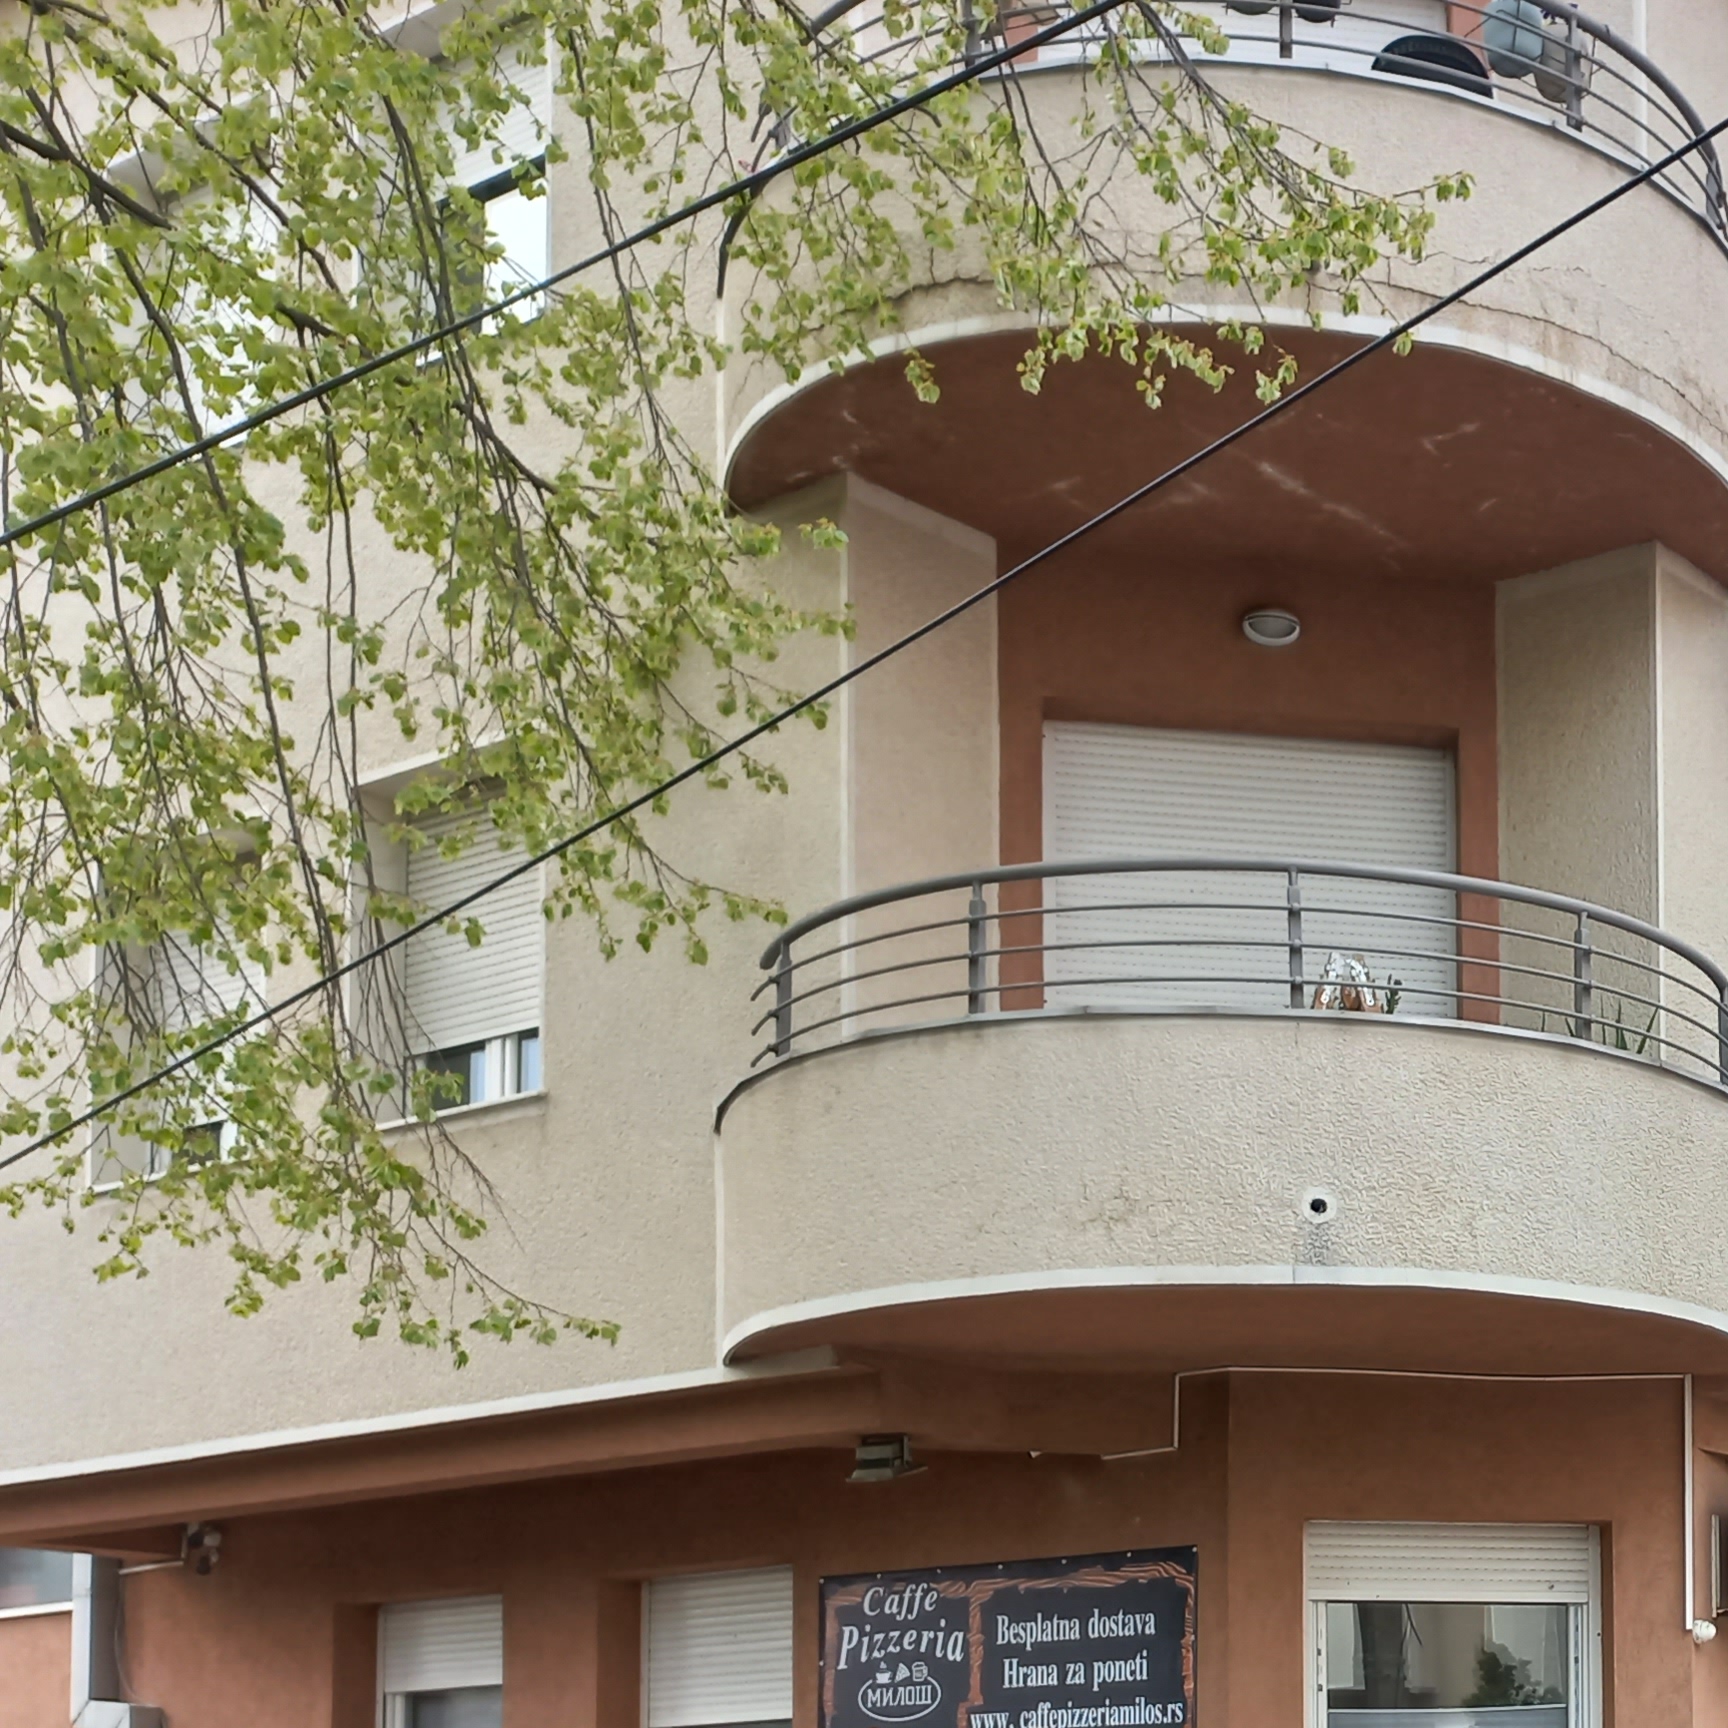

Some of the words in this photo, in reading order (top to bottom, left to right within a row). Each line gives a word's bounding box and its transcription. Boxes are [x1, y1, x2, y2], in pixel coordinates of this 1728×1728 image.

[864, 1583, 938, 1620] Caffe
[837, 1619, 963, 1669] Pizzeria
[997, 1613, 1080, 1651] Besplatna
[1088, 1609, 1155, 1638] dostava
[1003, 1659, 1057, 1688] Hrana
[1066, 1663, 1085, 1684] za
[1093, 1650, 1147, 1691] poneti
[868, 1685, 931, 1707] МИЛОШ
